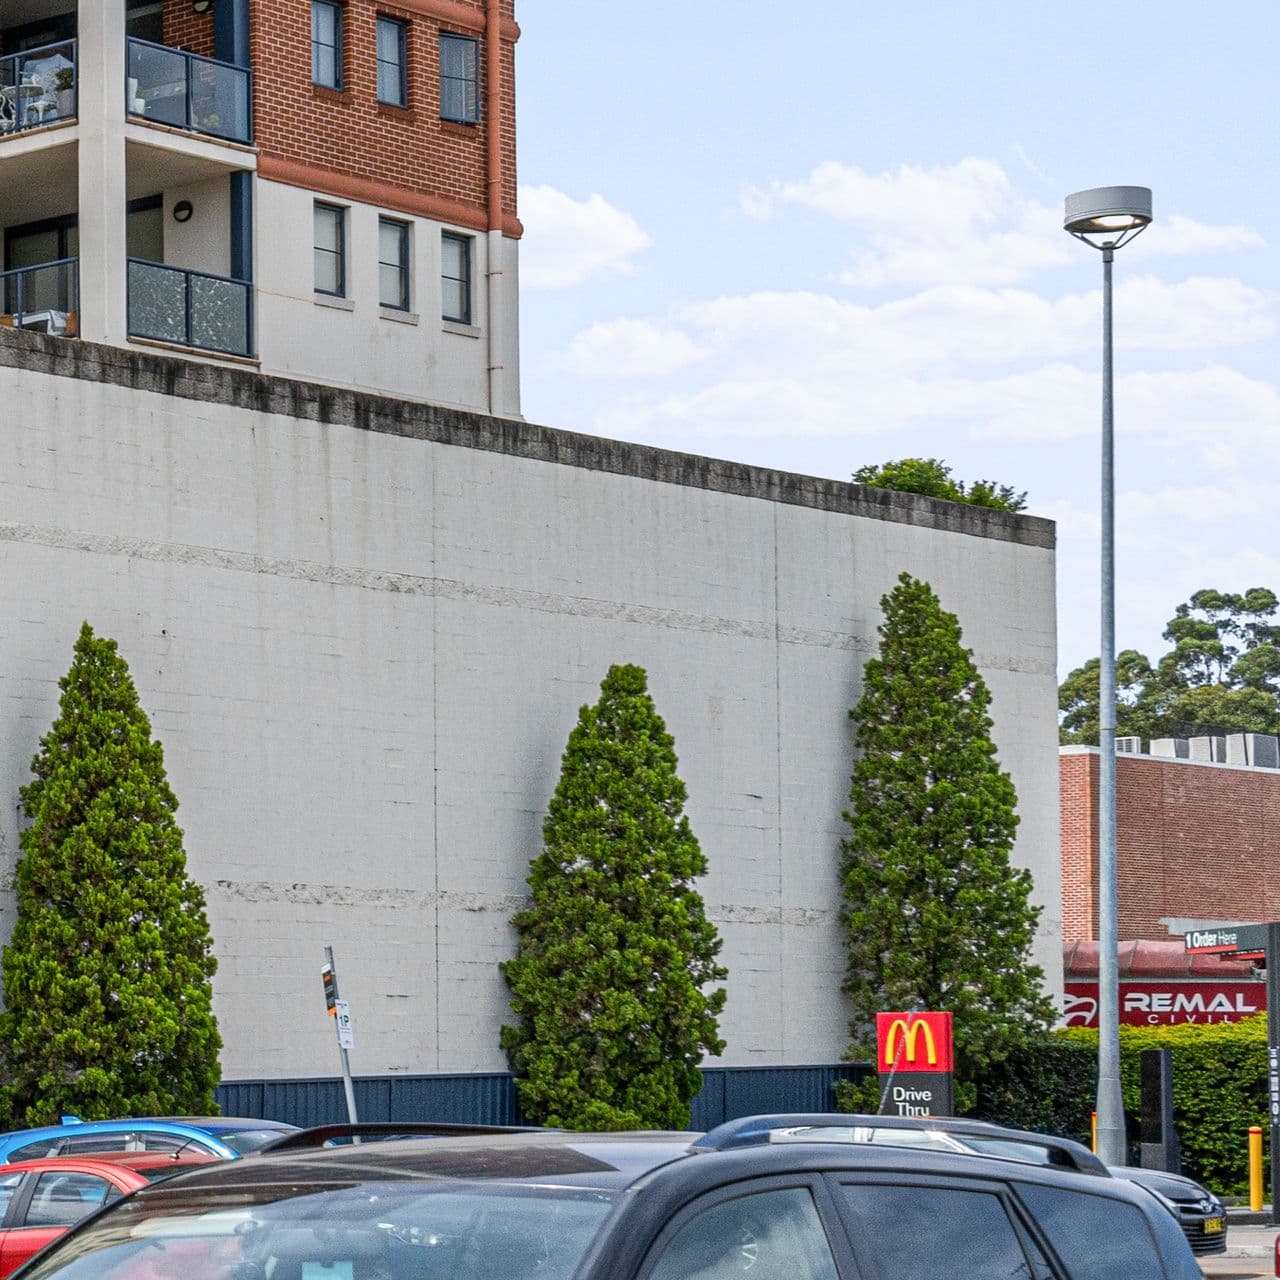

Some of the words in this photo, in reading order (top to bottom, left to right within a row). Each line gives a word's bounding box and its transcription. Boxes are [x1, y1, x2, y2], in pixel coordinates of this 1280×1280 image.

[1186, 933, 1192, 948] 1
[1192, 931, 1217, 947] Order
[1218, 930, 1237, 945] Here
[1124, 992, 1257, 1012] REMAL
[1147, 1014, 1233, 1024] CIVIL
[893, 1086, 932, 1101] Drive
[895, 1102, 930, 1116] Thru
